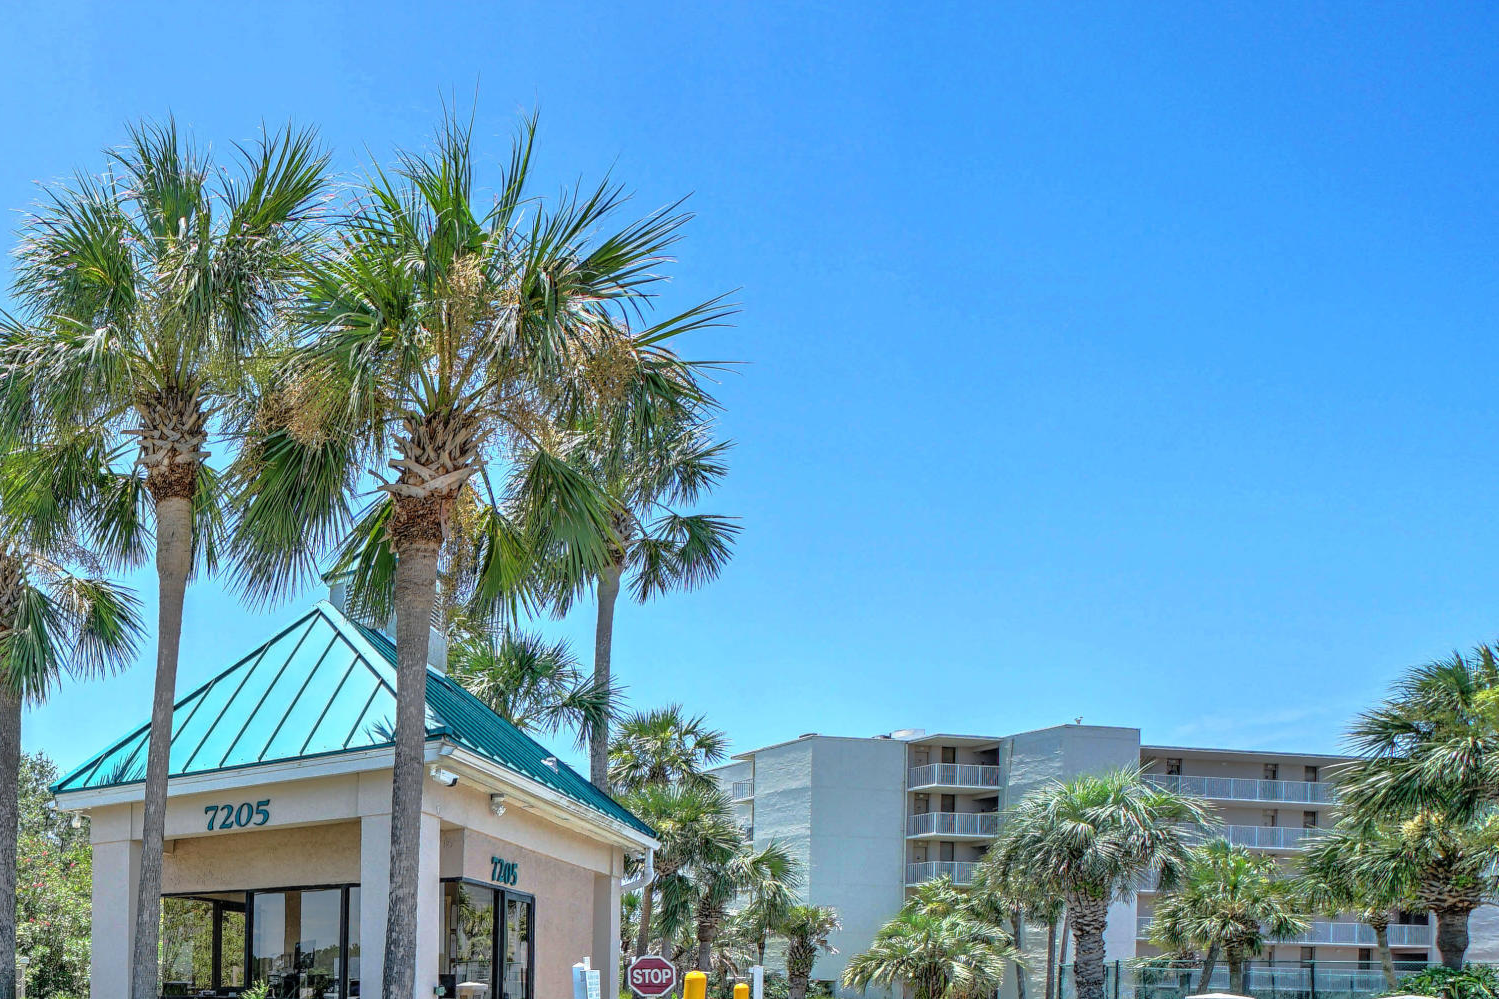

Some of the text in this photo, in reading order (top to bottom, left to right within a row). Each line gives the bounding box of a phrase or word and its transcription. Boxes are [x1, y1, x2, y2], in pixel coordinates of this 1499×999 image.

[204, 799, 271, 831] 7205
[491, 856, 518, 886] 7205
[632, 968, 671, 984] STOP
